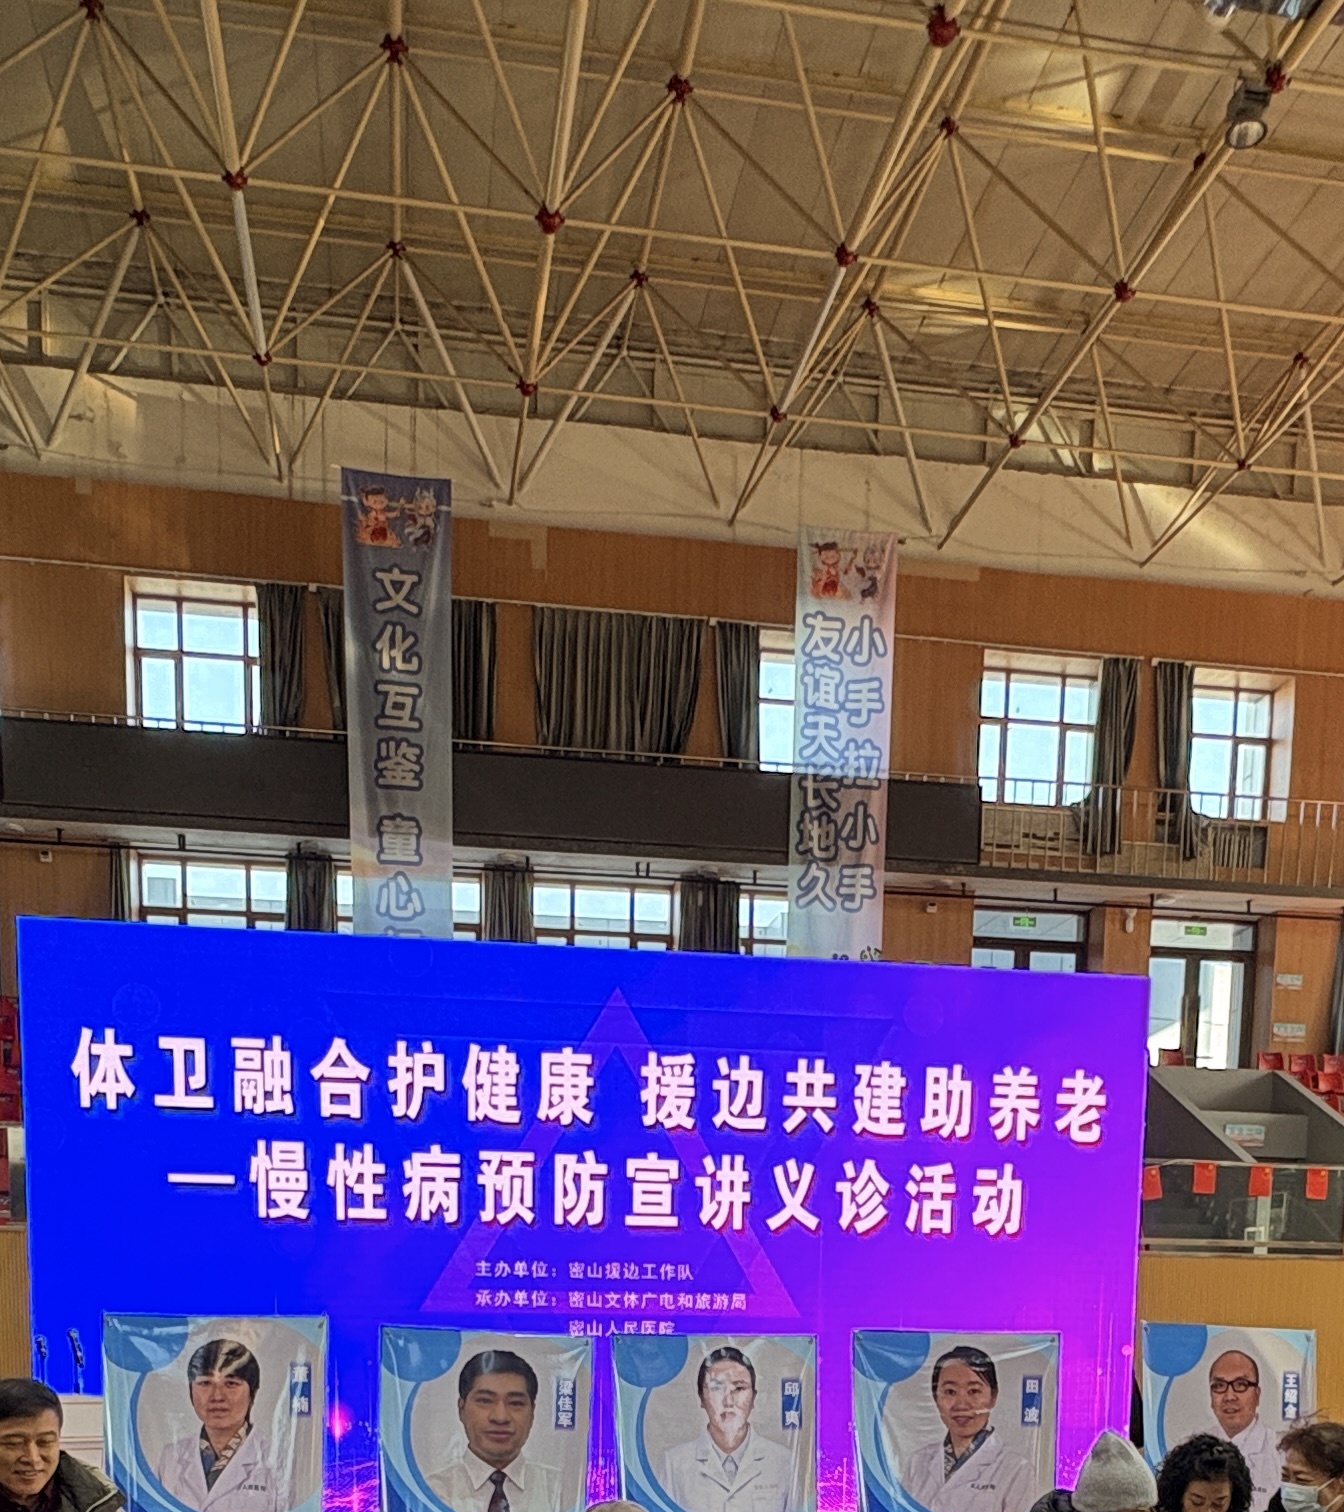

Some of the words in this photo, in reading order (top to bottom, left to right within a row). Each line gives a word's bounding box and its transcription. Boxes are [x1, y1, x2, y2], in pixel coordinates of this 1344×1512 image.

[373, 567, 423, 791] 文化互鉴
[796, 610, 845, 913] 友谊天长地久
[835, 615, 887, 913] 小手拉小手
[374, 813, 425, 936] 童心
[71, 1026, 594, 1126] 体卫融合护健康
[640, 1050, 1107, 1144] 援边共建助养老
